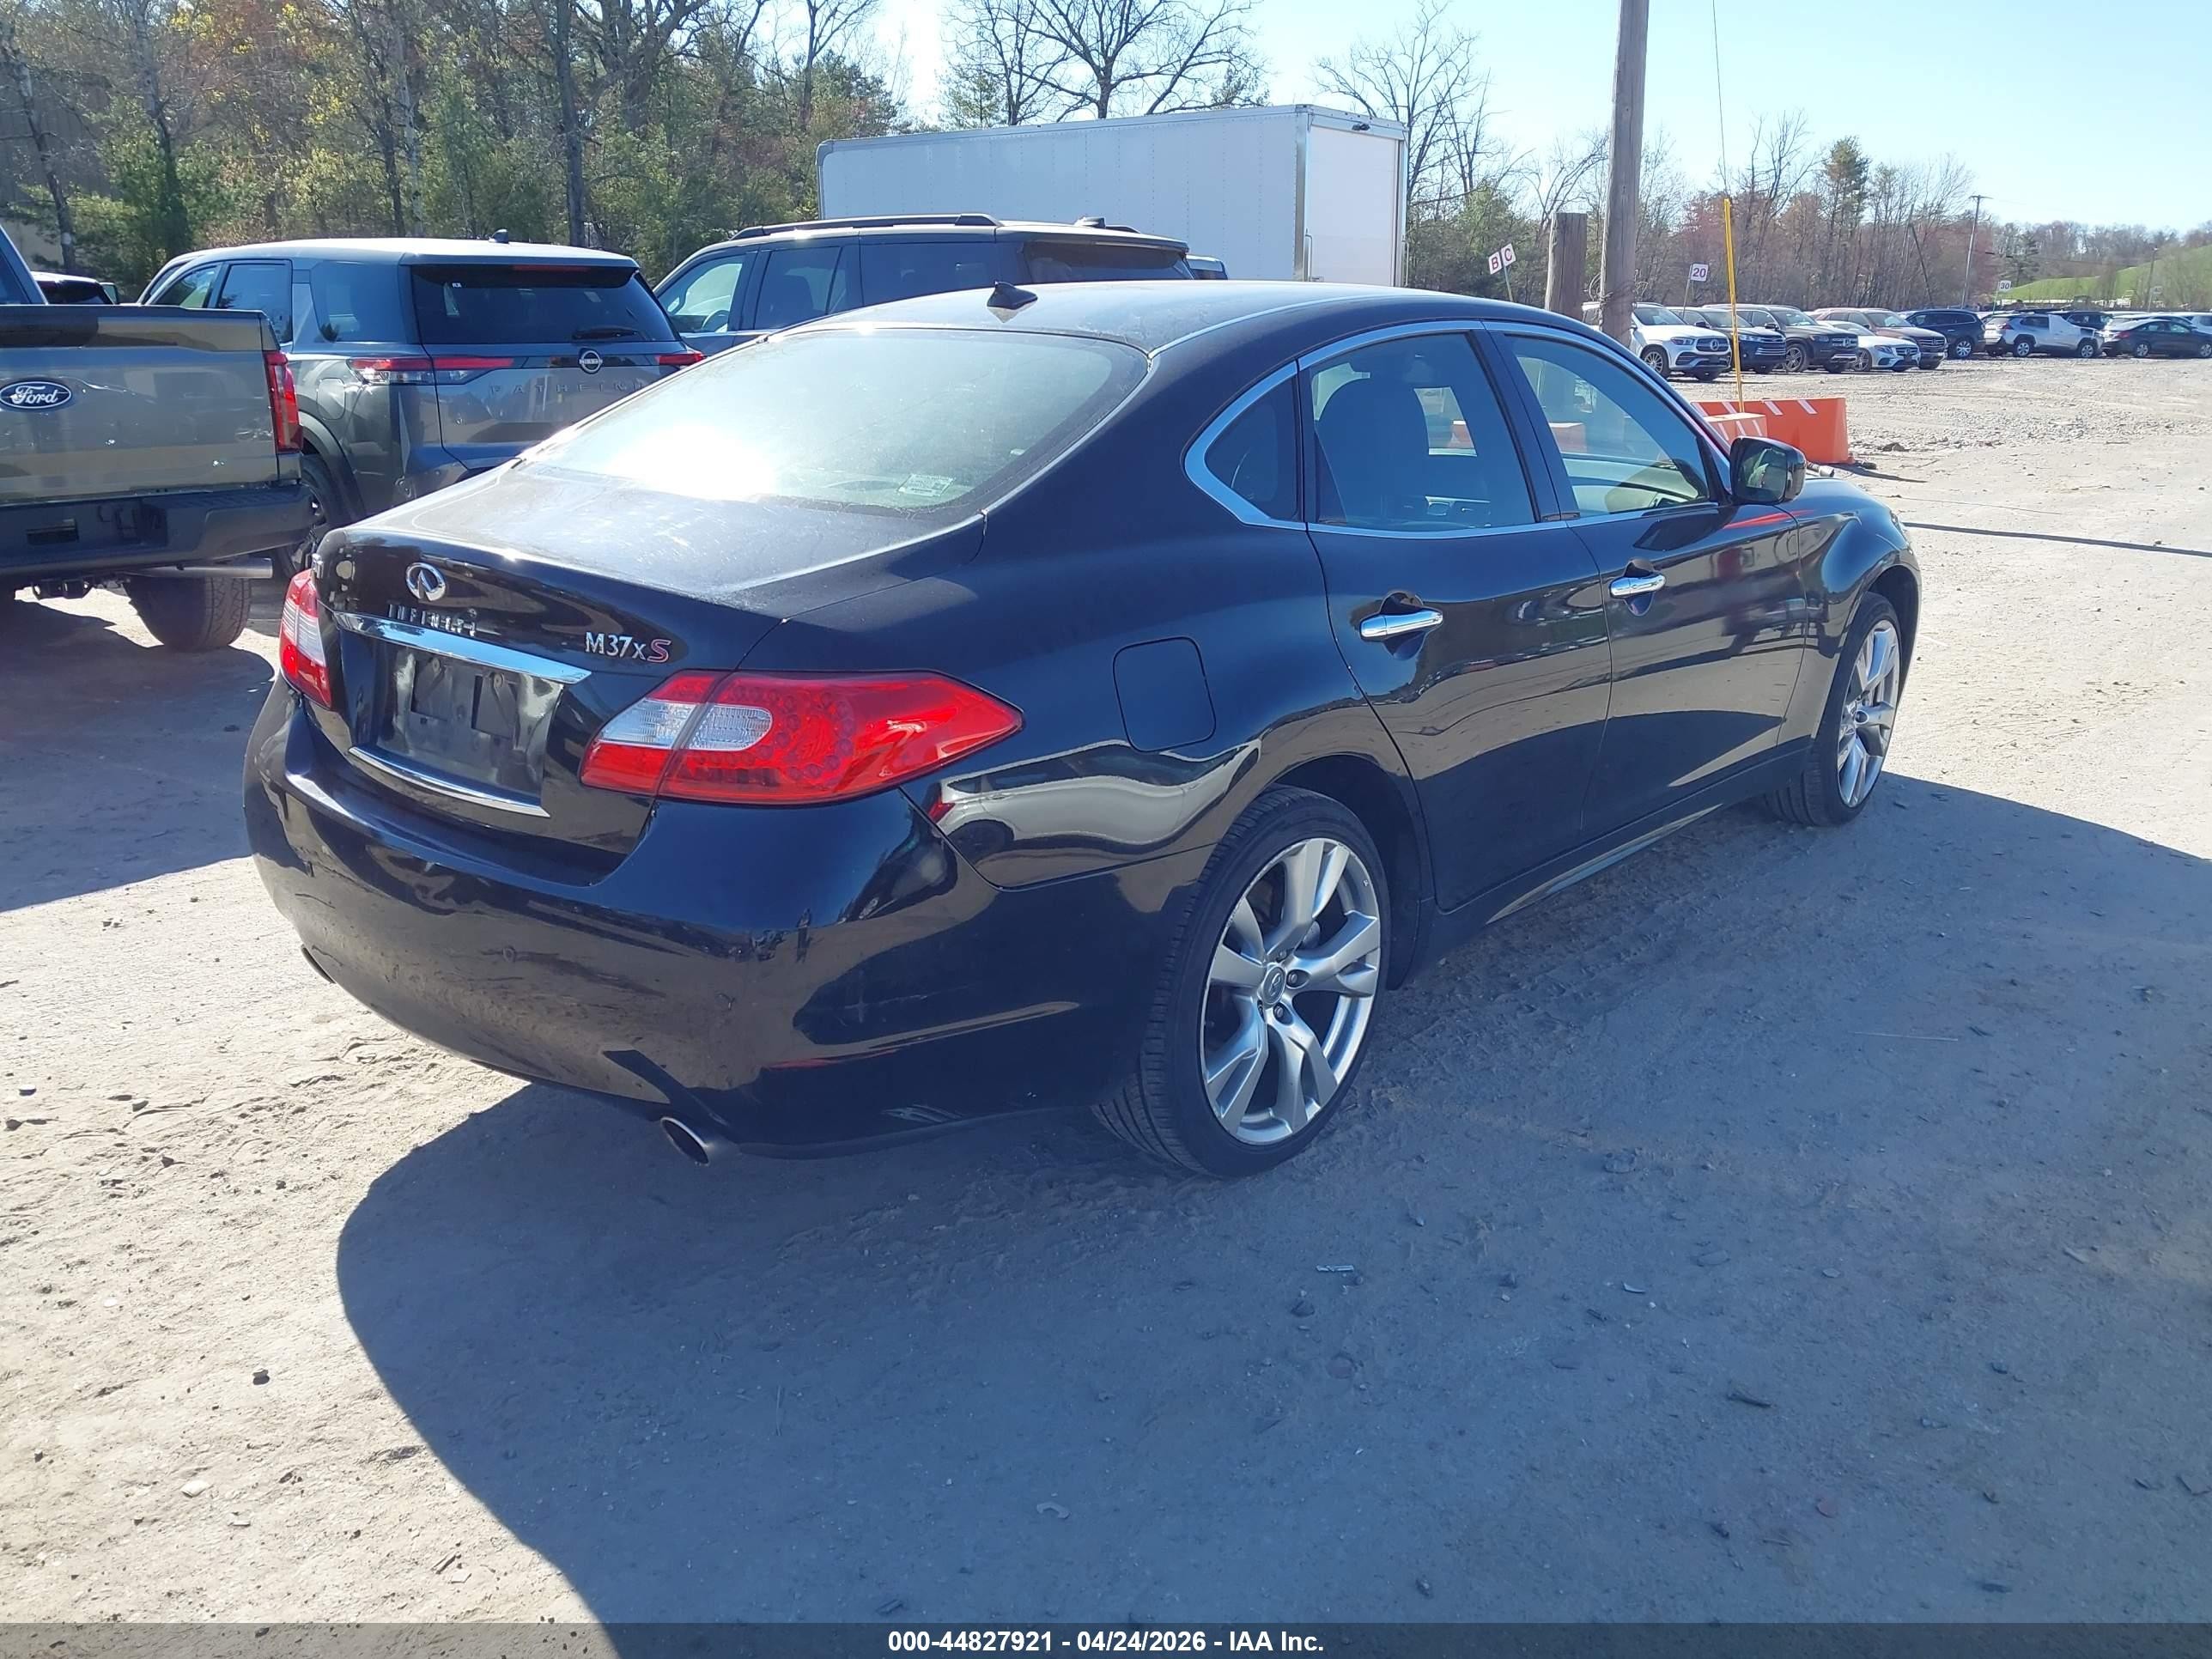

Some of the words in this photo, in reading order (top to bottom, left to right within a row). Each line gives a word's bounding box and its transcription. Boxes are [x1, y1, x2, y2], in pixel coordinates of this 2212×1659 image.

[1492, 256, 1499, 270] B
[1504, 248, 1513, 262] C
[1692, 267, 1706, 278] 20
[9, 385, 58, 404] Ford
